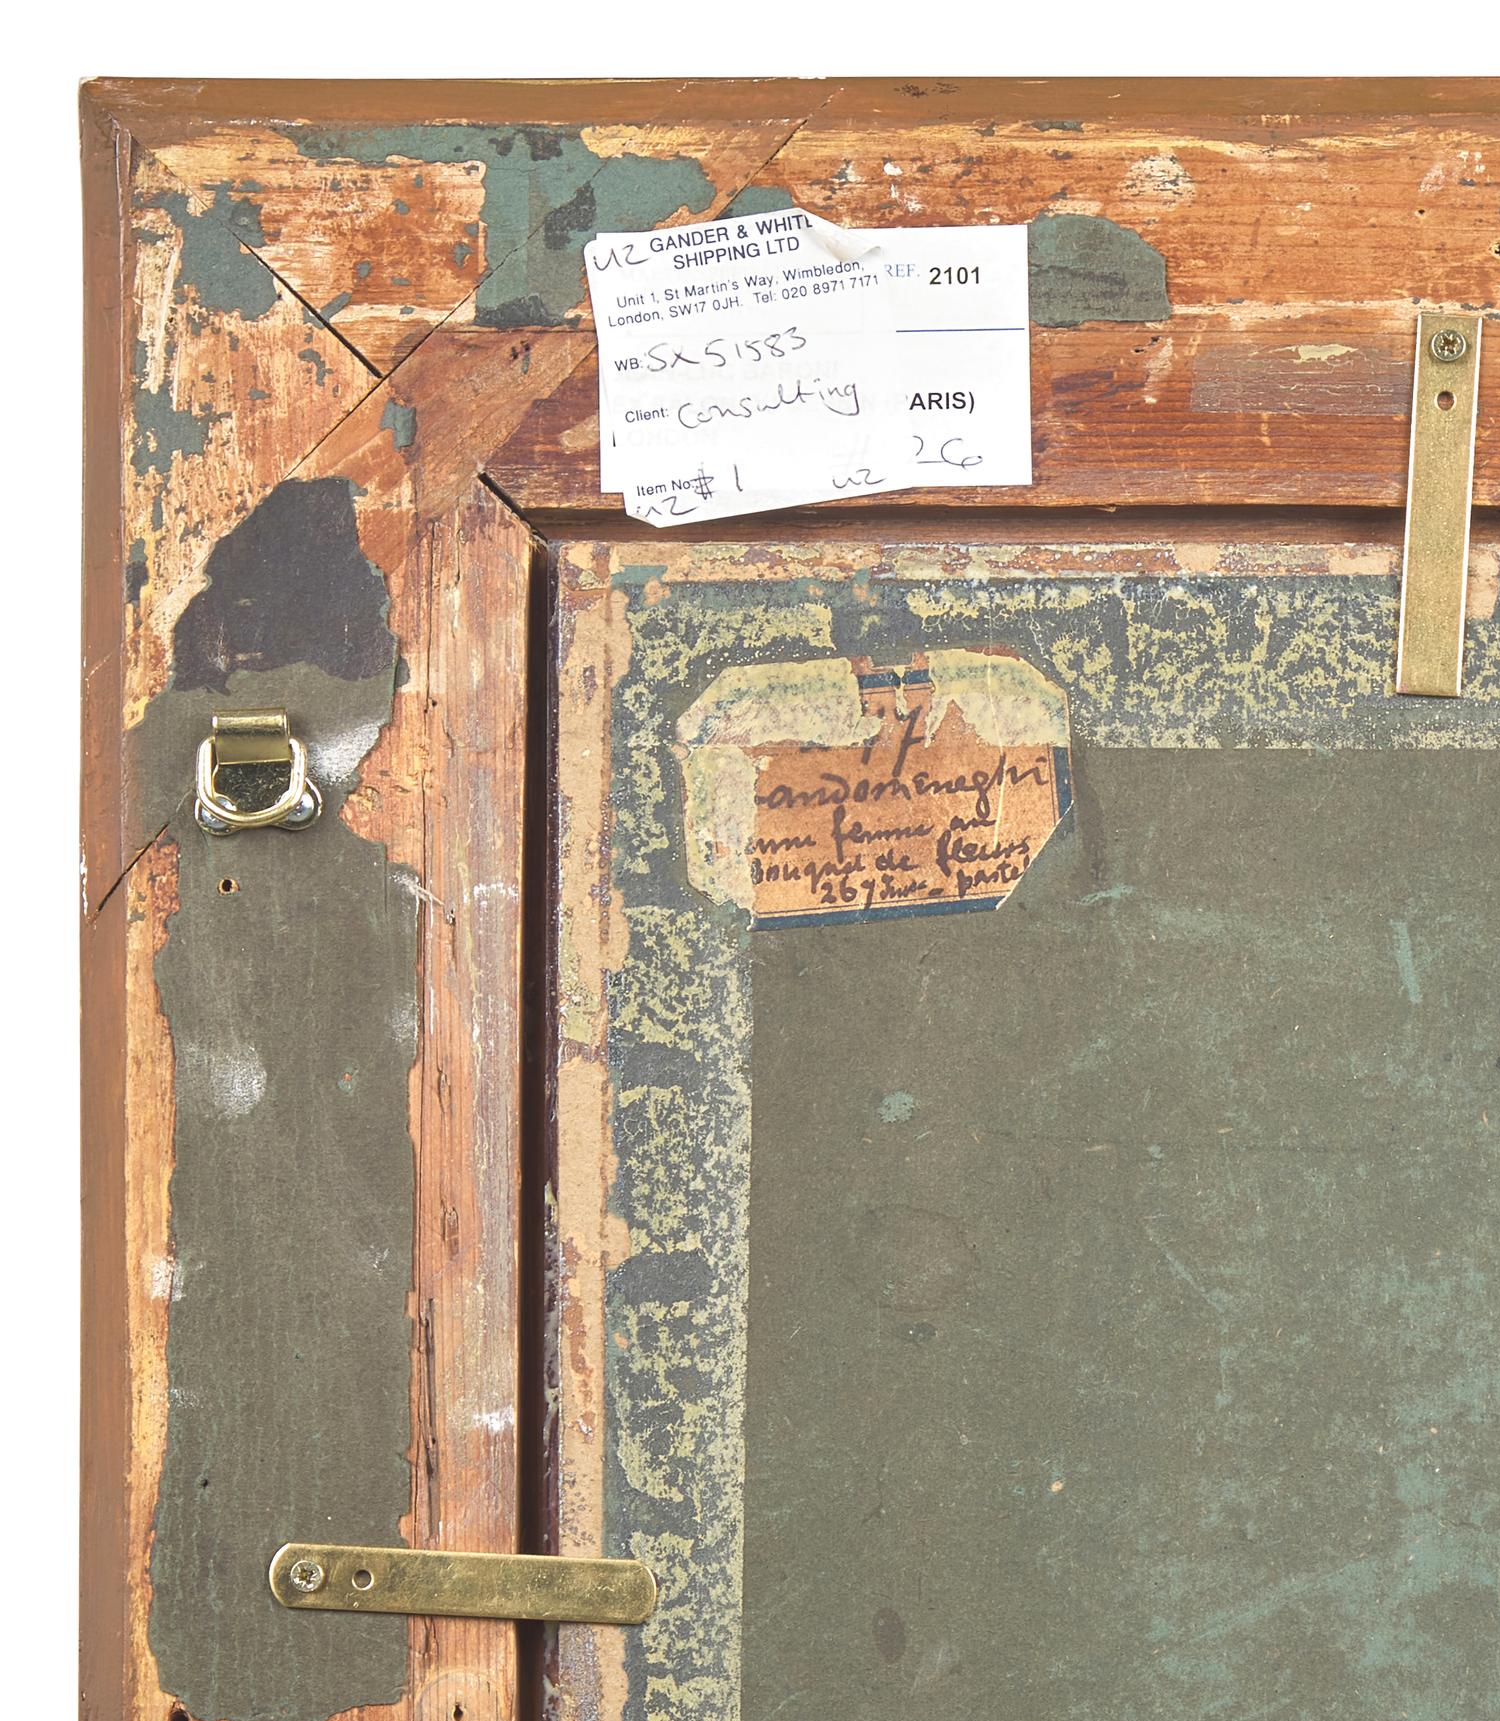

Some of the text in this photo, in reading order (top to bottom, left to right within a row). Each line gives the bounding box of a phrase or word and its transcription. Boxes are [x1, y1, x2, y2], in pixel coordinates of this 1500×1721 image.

[649, 226, 731, 255] GANDER
[736, 224, 749, 241] &
[672, 234, 801, 270] SHIPPING LTD
[885, 262, 921, 280] REF.
[929, 265, 983, 286] 2101
[616, 257, 866, 309] Unit 1, St Martin's Way, Wimbledon,
[608, 273, 880, 329] London, SW17 0JH. Tel: 020 8971 7171
[614, 356, 644, 373] WB:
[905, 390, 976, 415] ARIS)
[625, 406, 669, 425] Client:
[636, 481, 669, 498] Item
